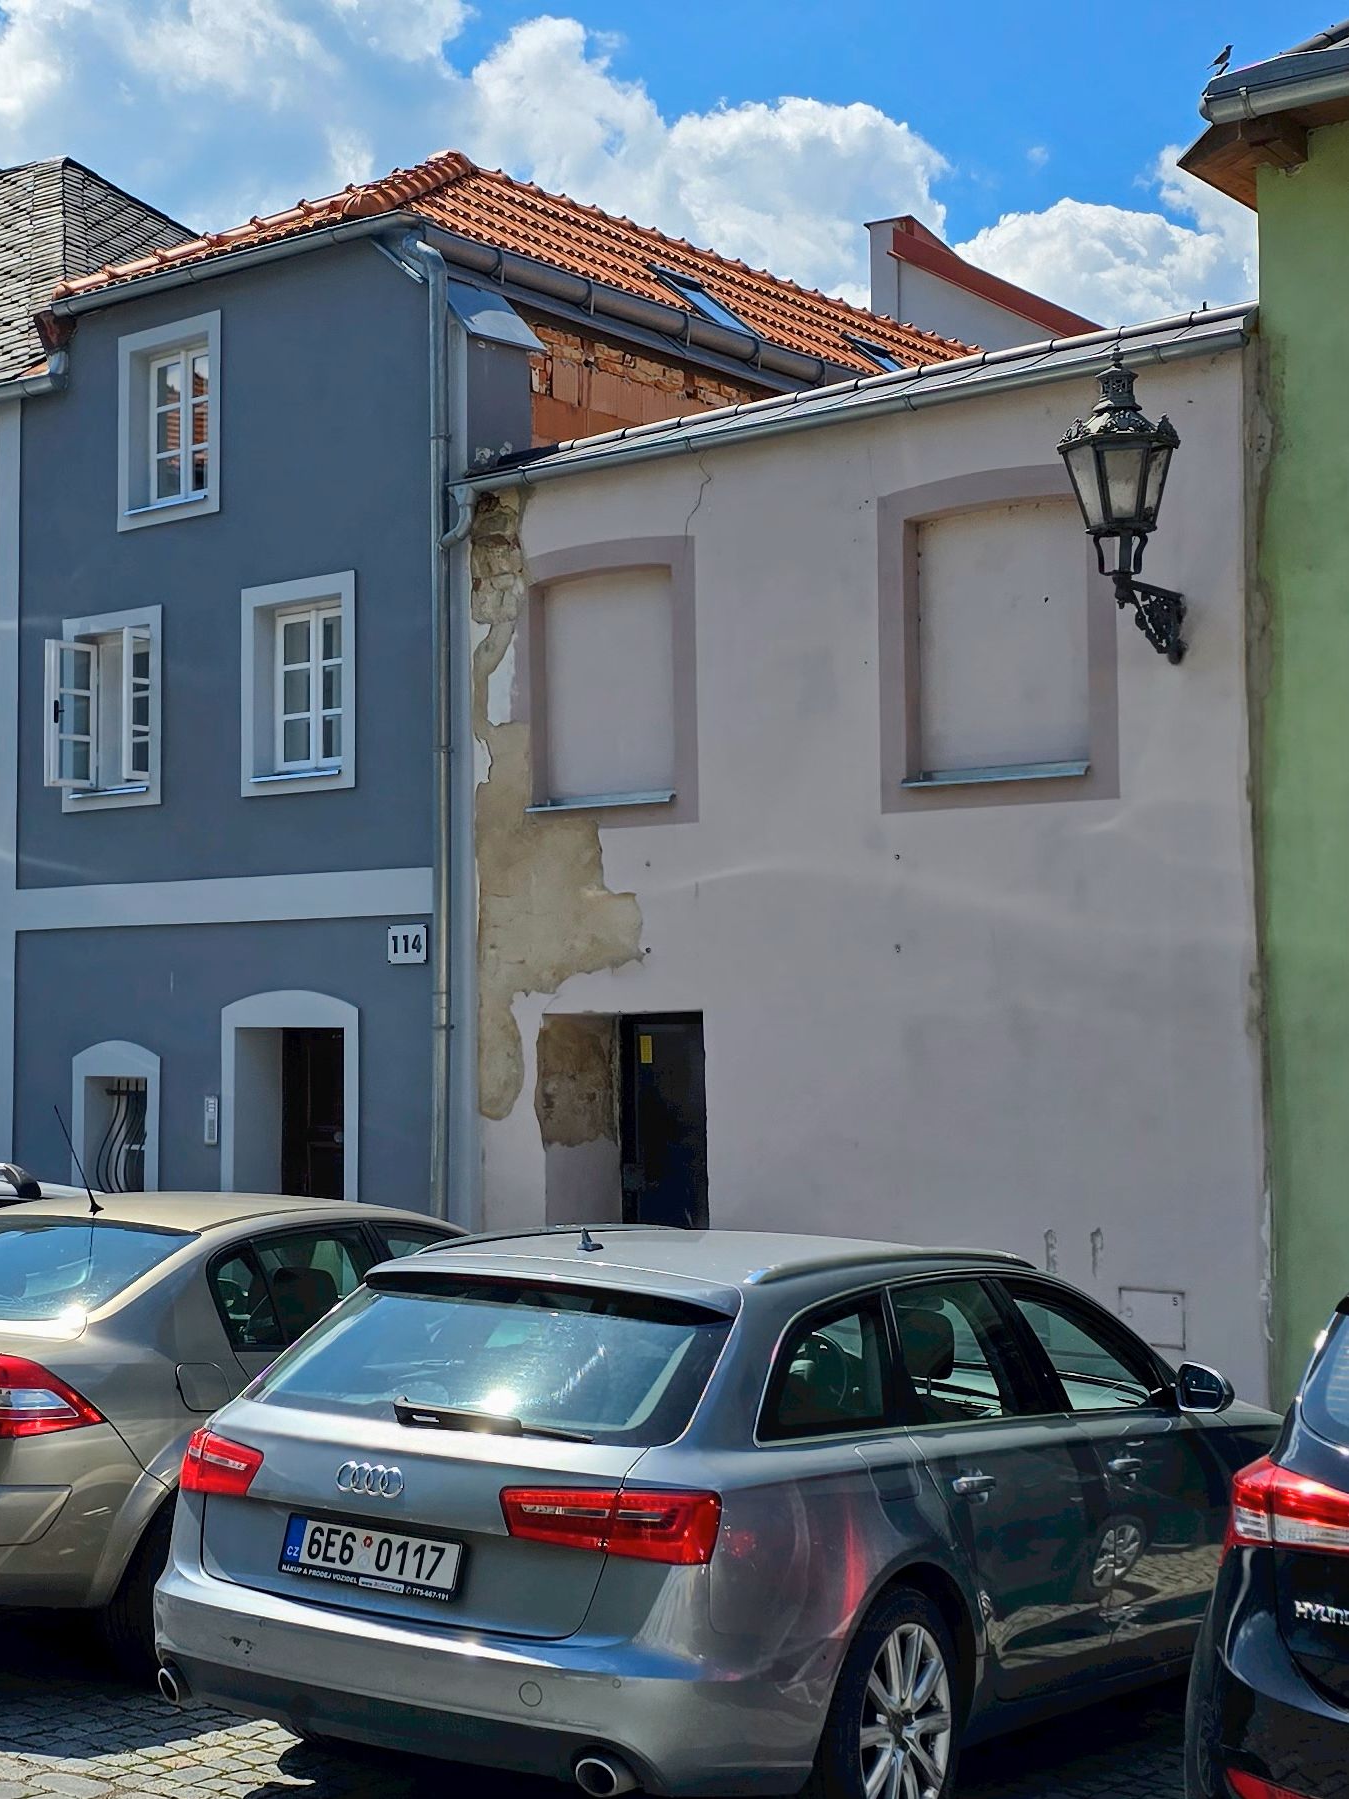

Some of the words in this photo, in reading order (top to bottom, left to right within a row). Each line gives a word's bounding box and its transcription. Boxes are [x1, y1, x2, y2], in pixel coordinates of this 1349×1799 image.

[392, 935, 422, 953] 114
[287, 1545, 300, 1557] CZ
[307, 1526, 357, 1566] 6E6
[375, 1537, 446, 1581] 0117
